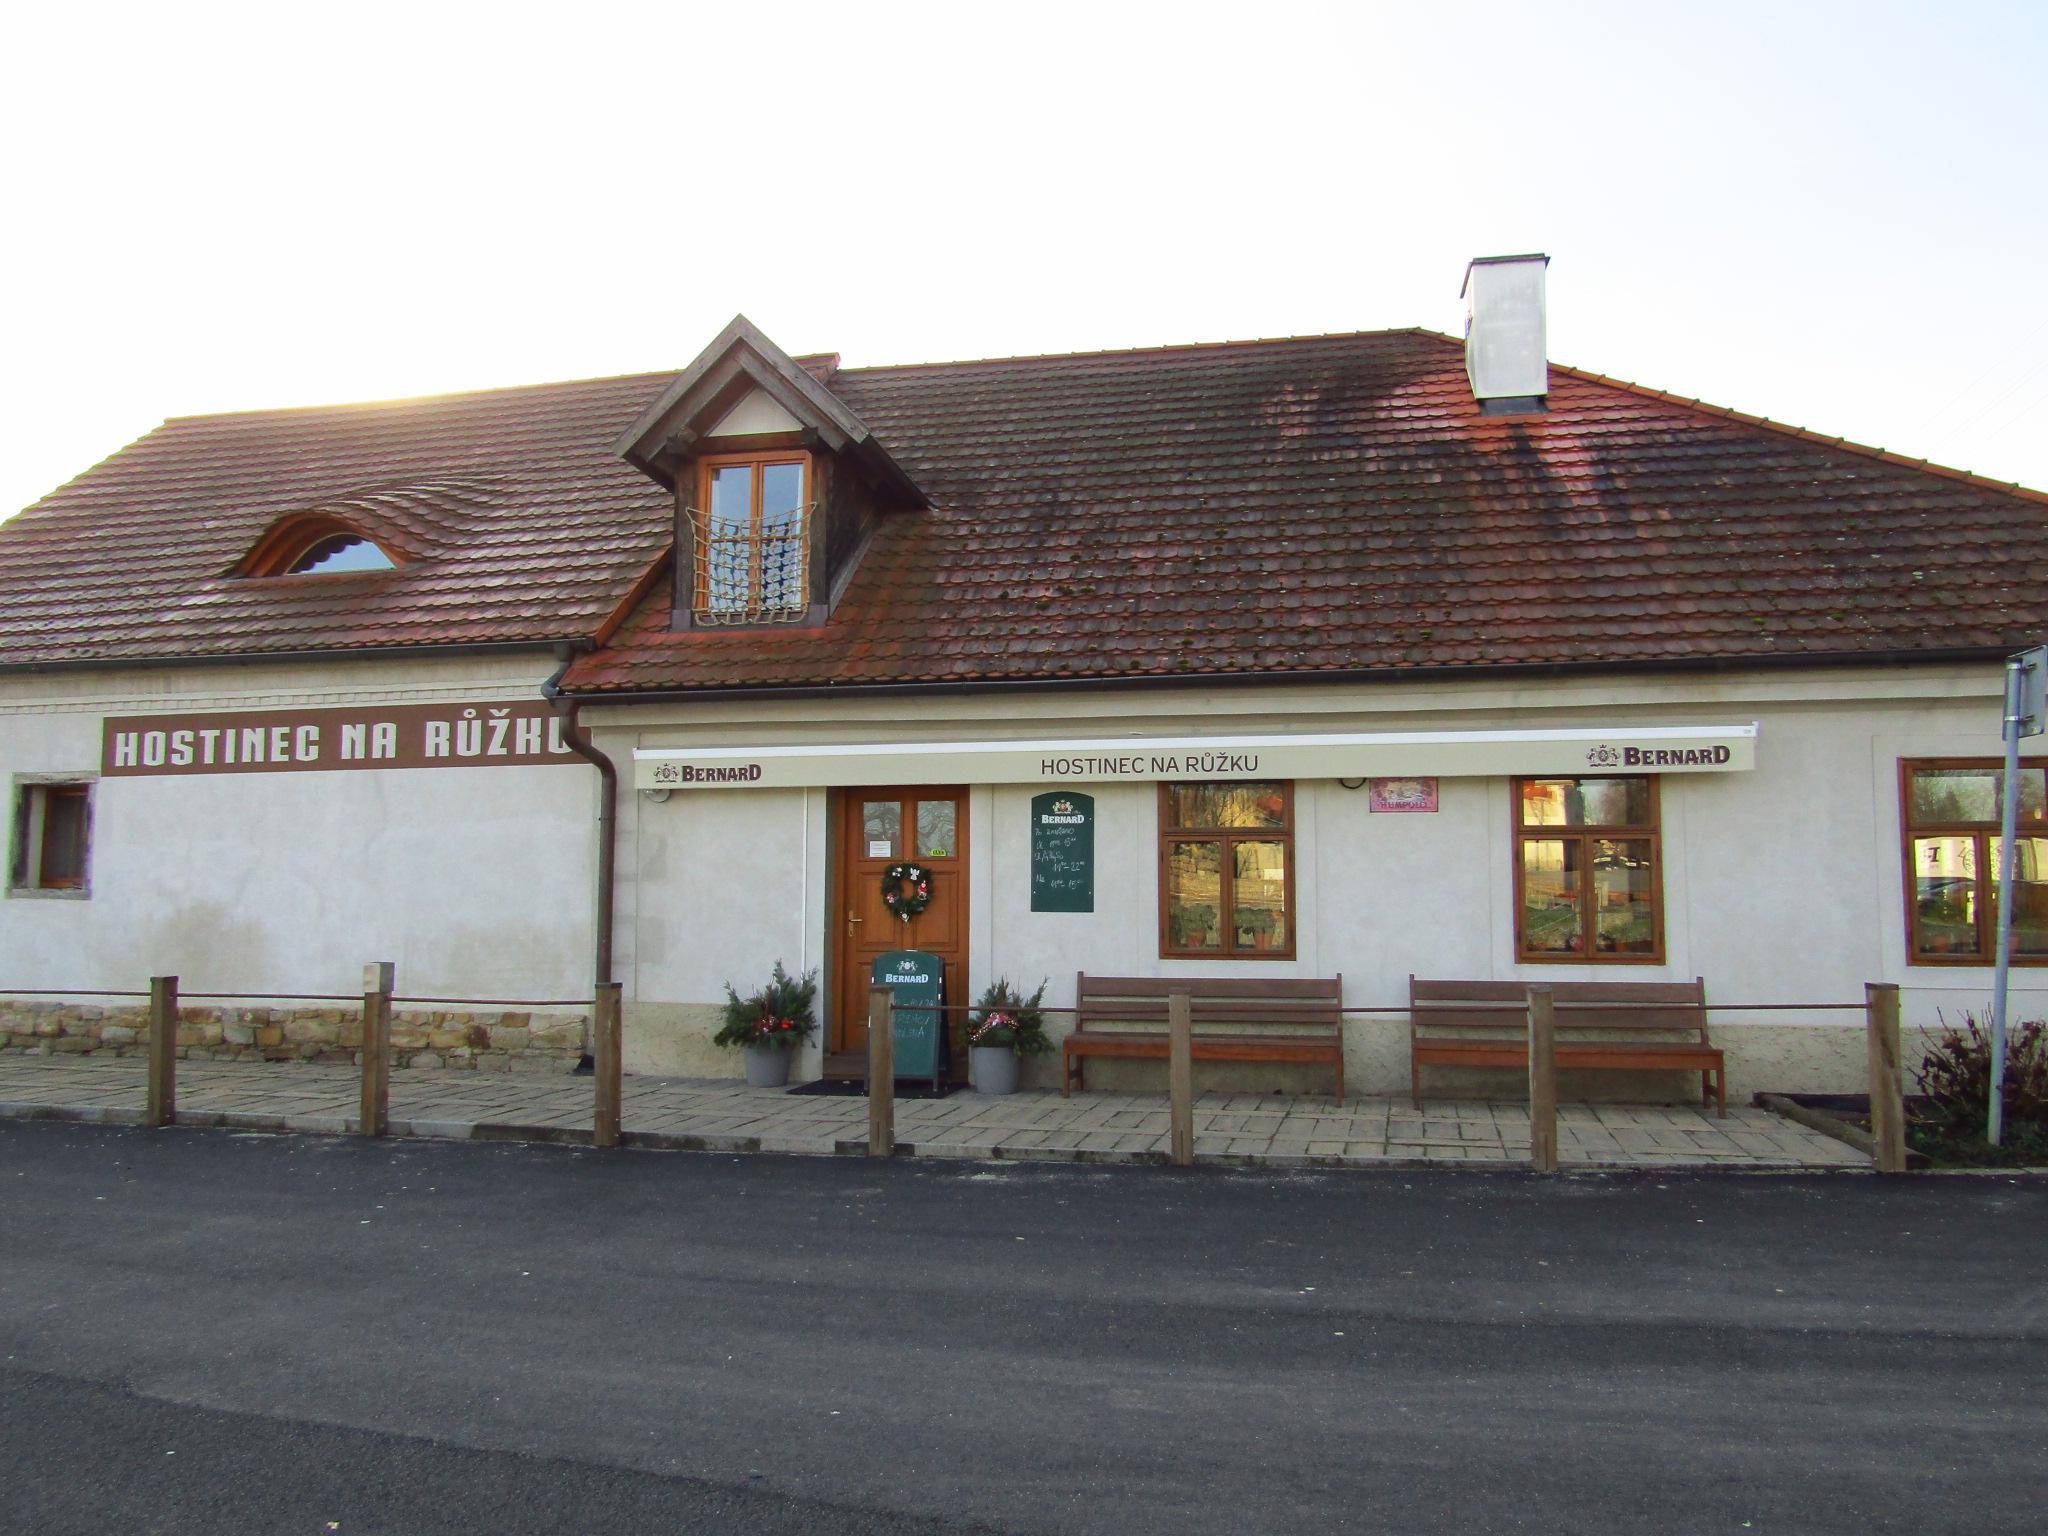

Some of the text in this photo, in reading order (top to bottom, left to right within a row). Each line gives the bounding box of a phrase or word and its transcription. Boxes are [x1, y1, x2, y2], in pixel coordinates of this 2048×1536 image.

[114, 724, 321, 768] HOSTINEC
[340, 721, 398, 760] NA
[1040, 750, 1258, 776] HOSTINEC NA RŮŽKU
[1623, 744, 1731, 767] BERNARD
[681, 763, 762, 783] BERNARD
[1041, 814, 1085, 824] BERNARD
[885, 973, 929, 984] BERNARD
